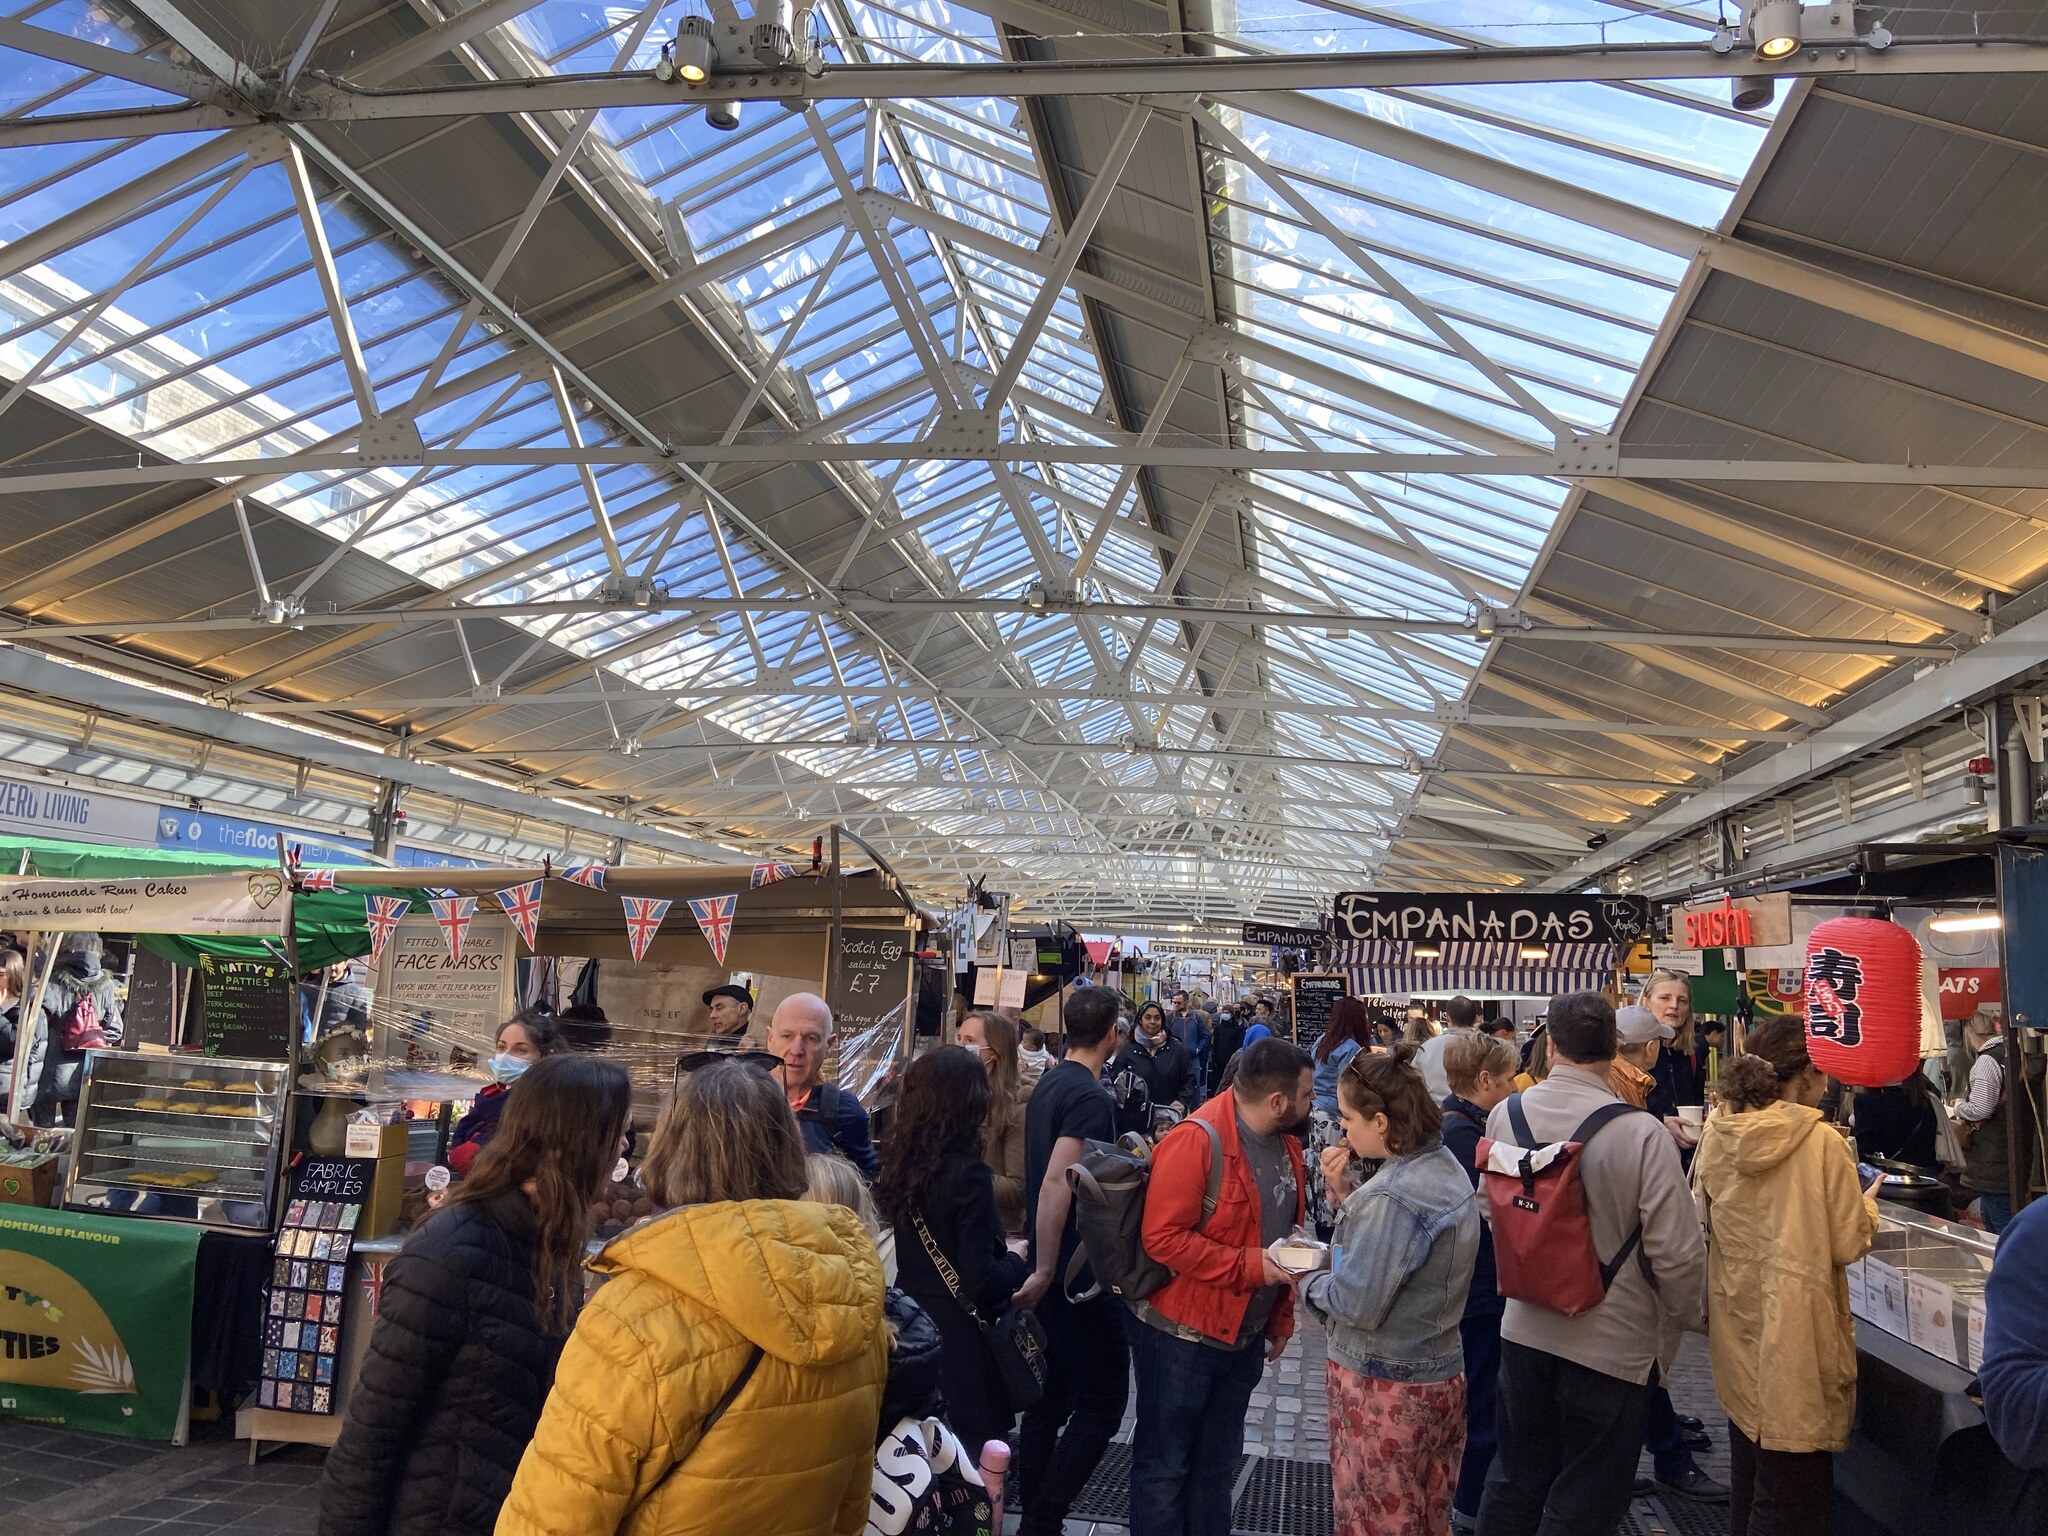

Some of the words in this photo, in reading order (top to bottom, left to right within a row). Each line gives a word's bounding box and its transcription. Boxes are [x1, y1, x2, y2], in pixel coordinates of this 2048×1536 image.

[43, 792, 90, 824] LIVING
[219, 823, 280, 851] thefloo
[12, 888, 97, 901] Homemade
[101, 885, 138, 896] Rum
[145, 882, 188, 897] Cakes
[13, 909, 38, 917] taste
[42, 906, 51, 915] &
[54, 906, 82, 915] bakes
[86, 904, 107, 915] with
[110, 904, 134, 915] love!
[1337, 894, 1594, 941] EMPANADAS
[1610, 902, 1630, 917] The
[1685, 895, 1752, 949] sushi
[405, 937, 440, 948] FITTED
[1245, 926, 1325, 950] EMPANADAS
[841, 937, 877, 955] Scotch
[880, 940, 904, 962] Egg
[1153, 944, 1218, 956] GREENWICH
[1221, 948, 1267, 958] MARKET
[219, 962, 275, 978] NATTY'S
[394, 953, 440, 970] FACE
[440, 954, 503, 971] MASKS
[848, 960, 871, 970] salad
[872, 961, 888, 971] box
[225, 975, 270, 988] PATTIES
[395, 983, 416, 991] NOSE
[442, 983, 468, 991] FILTER
[469, 984, 498, 992] POCKET
[849, 972, 881, 995] £7
[1300, 979, 1341, 989] EMPANADAS
[1939, 976, 1981, 994] ATS
[206, 990, 224, 998] BEEF
[841, 1013, 853, 1022] tch
[855, 1014, 871, 1026] eggs
[208, 1031, 225, 1039] LAMB
[841, 1023, 856, 1034] sage
[305, 1162, 362, 1180] FABRIC
[298, 1179, 364, 1196] SAMPLES
[64, 1229, 121, 1245] FLAVOUR
